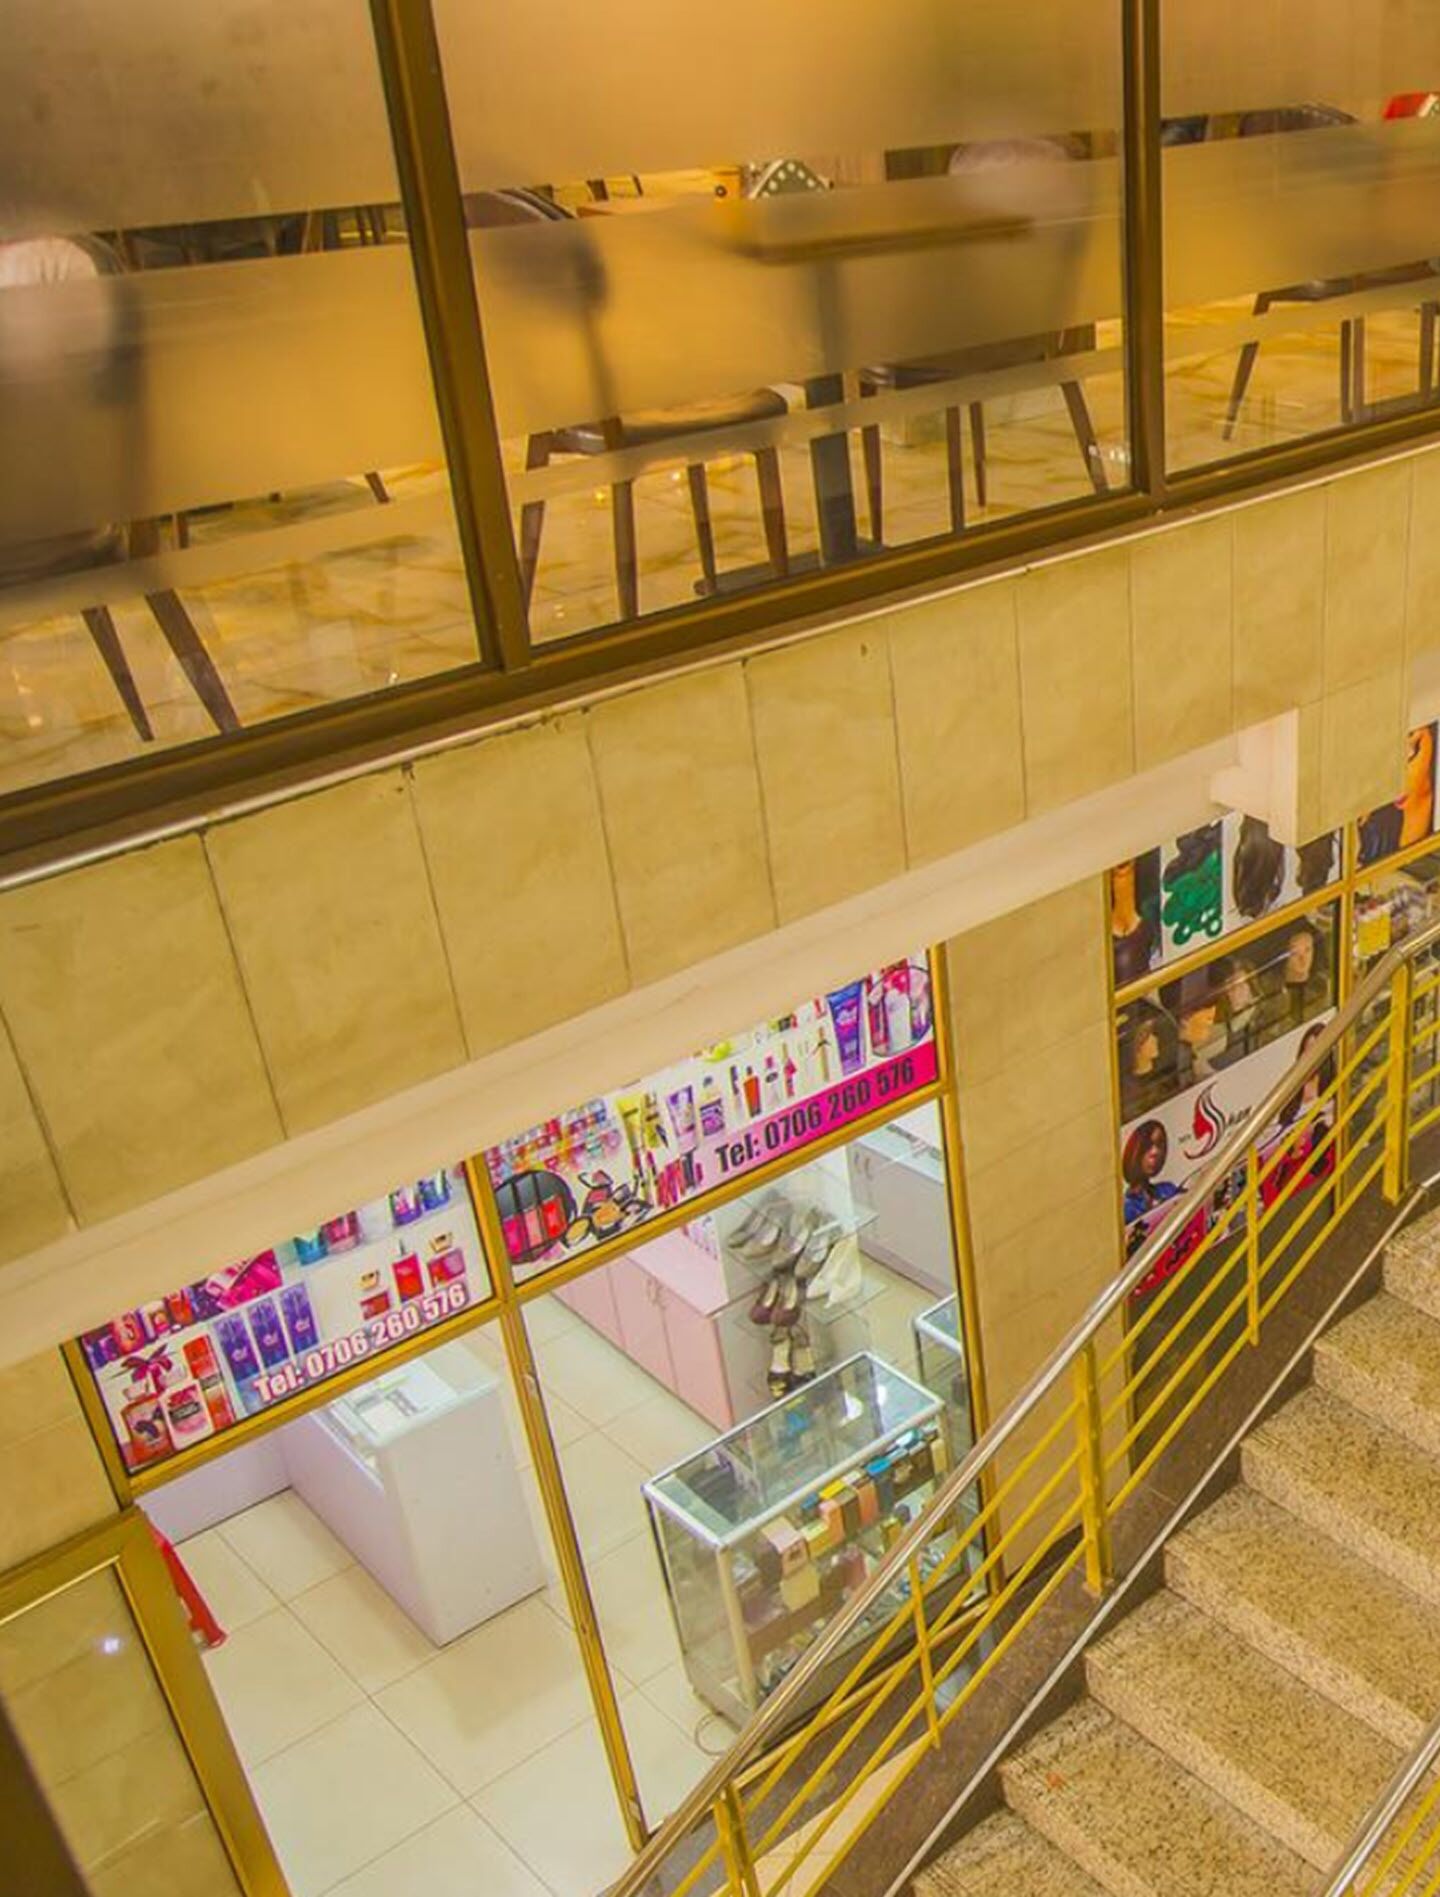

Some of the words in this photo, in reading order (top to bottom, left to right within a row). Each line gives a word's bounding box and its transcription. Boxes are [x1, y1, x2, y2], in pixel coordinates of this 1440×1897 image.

[715, 1133, 761, 1172] Tel:
[764, 1102, 821, 1150] 0706
[827, 1079, 871, 1121] 260
[876, 1057, 915, 1096] 576
[253, 1364, 304, 1401] Tel:
[305, 1331, 369, 1380] 0706
[371, 1306, 420, 1346] 260
[423, 1283, 467, 1322] 576
